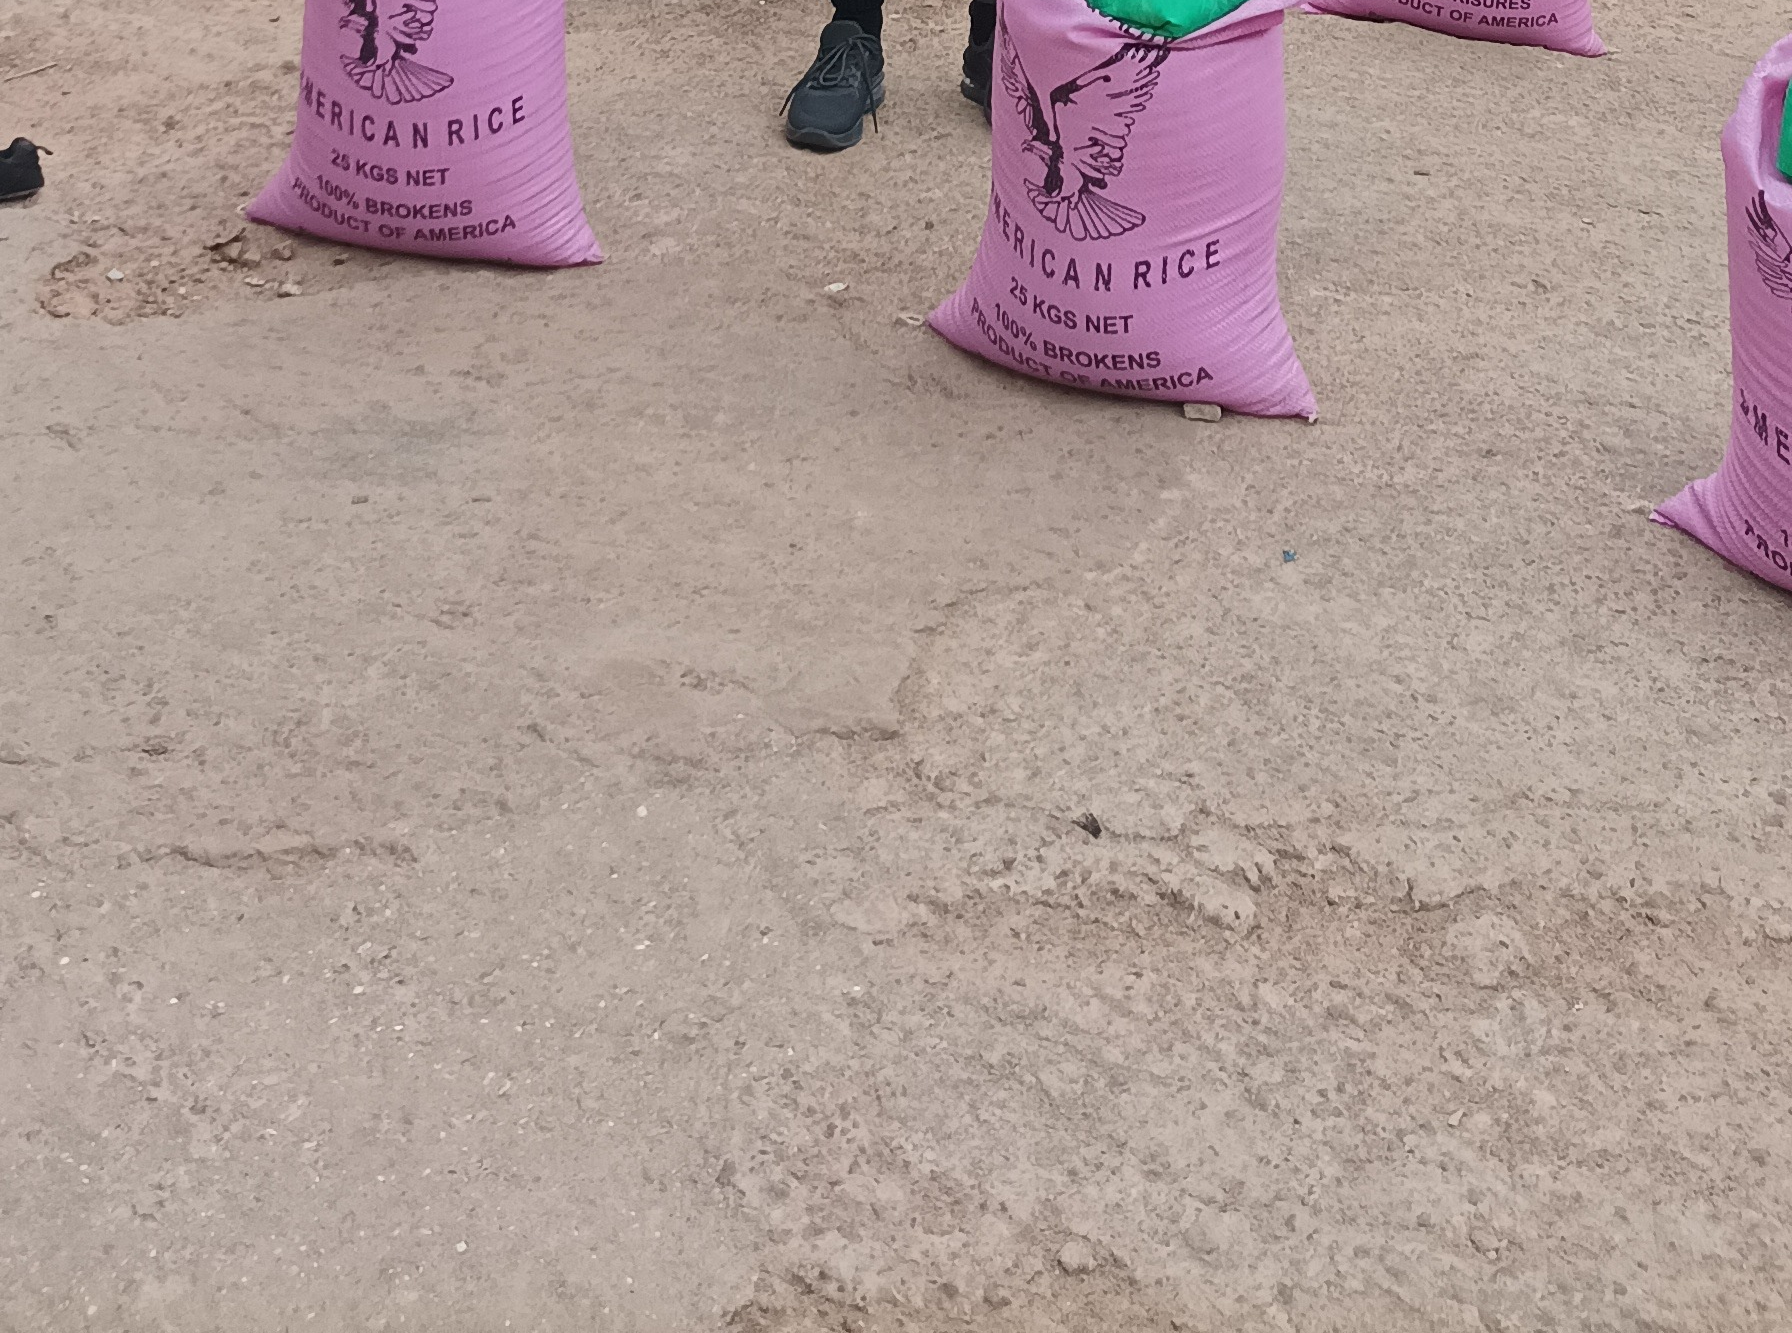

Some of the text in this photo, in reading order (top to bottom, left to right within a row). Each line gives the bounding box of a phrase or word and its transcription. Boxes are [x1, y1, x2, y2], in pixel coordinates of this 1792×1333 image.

[1449, 8, 1474, 24] OF
[1477, 12, 1559, 29] AMERICA
[447, 95, 527, 148] RICE
[316, 175, 473, 220] 100% BROKENS
[330, 148, 450, 187] 25 KGS NET
[291, 176, 517, 242] PRODUCT OF AMERICA
[993, 191, 1222, 292] MERICAN RICE
[1009, 275, 1134, 335] 25 KGS NET
[970, 296, 1214, 392] PRODUCT OF AMERICA
[994, 301, 1161, 371] 100% BROKENS
